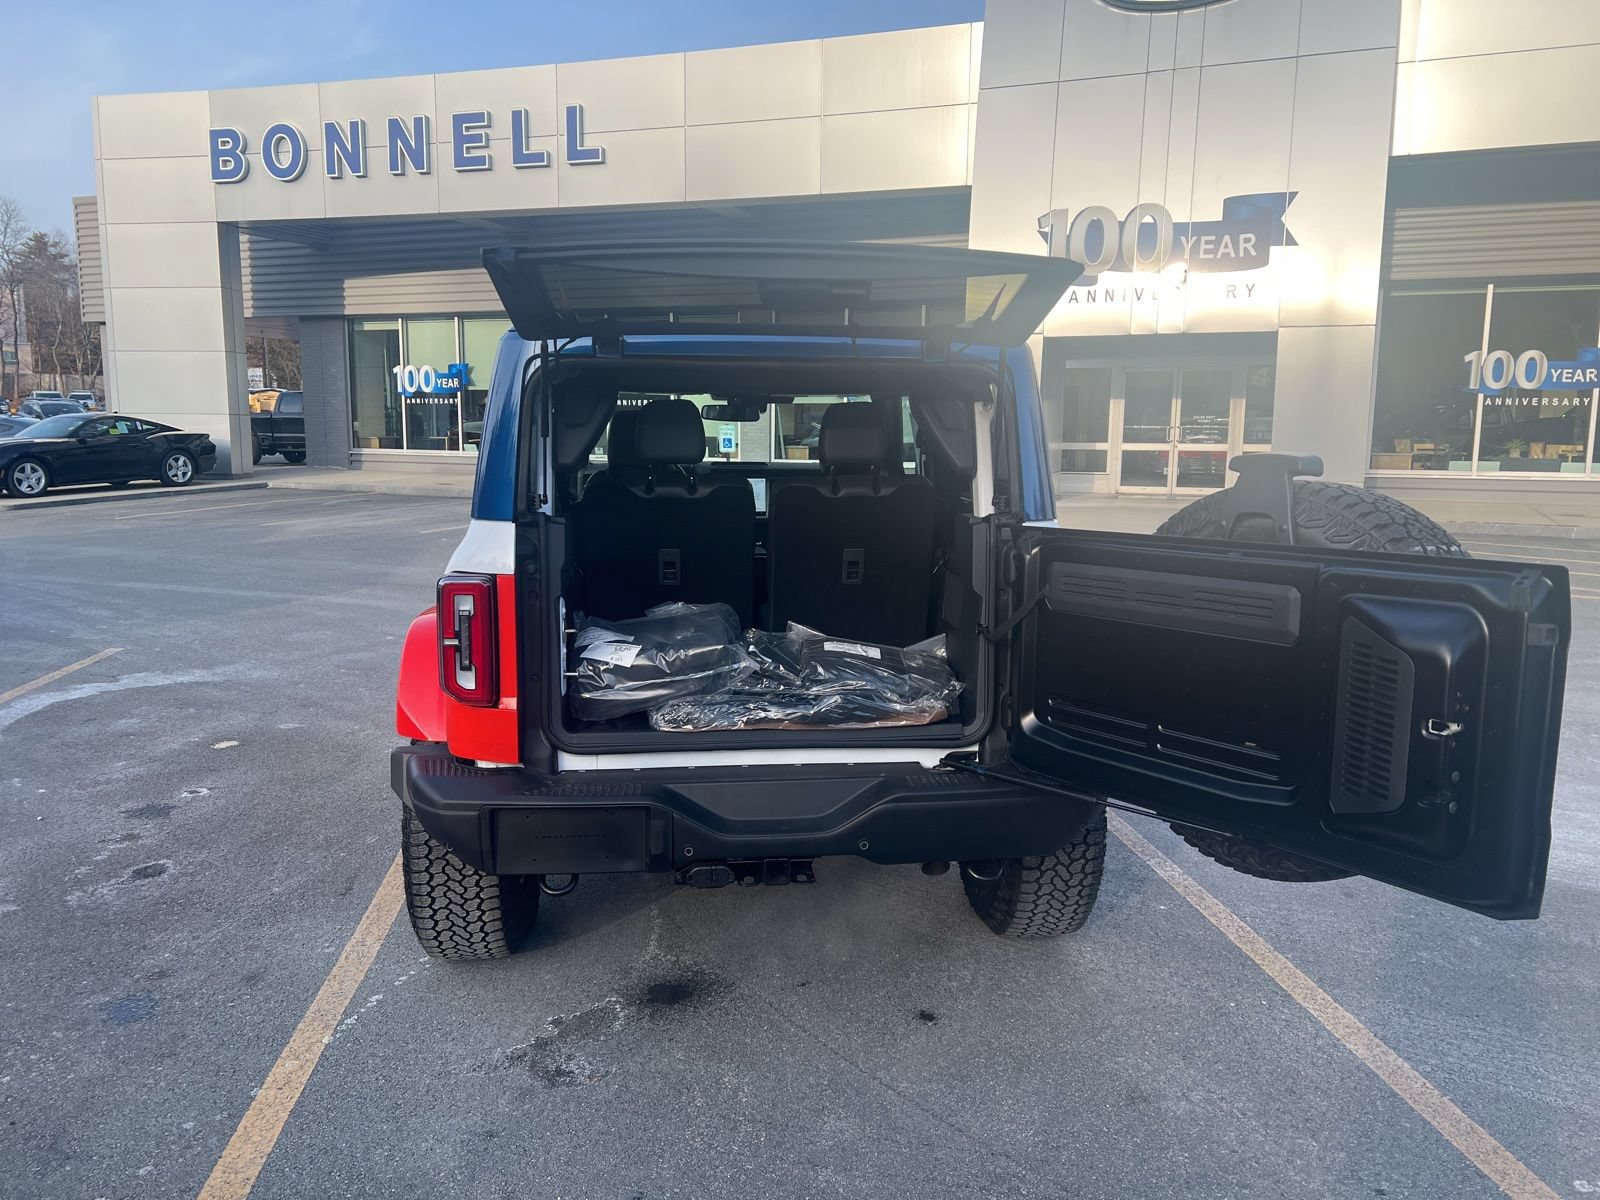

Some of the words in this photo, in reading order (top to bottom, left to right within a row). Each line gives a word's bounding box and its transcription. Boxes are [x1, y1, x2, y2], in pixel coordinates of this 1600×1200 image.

[208, 104, 605, 184] BONNELL
[1038, 203, 1174, 276] 100
[1180, 233, 1257, 260] YEAR
[1069, 283, 1256, 303] ANNIVRY
[392, 364, 435, 393] 100
[436, 378, 459, 388] YEAR
[1464, 350, 1548, 390] 100
[1551, 368, 1598, 383] YEAR
[1485, 397, 1591, 406] ANNIVERSARY
